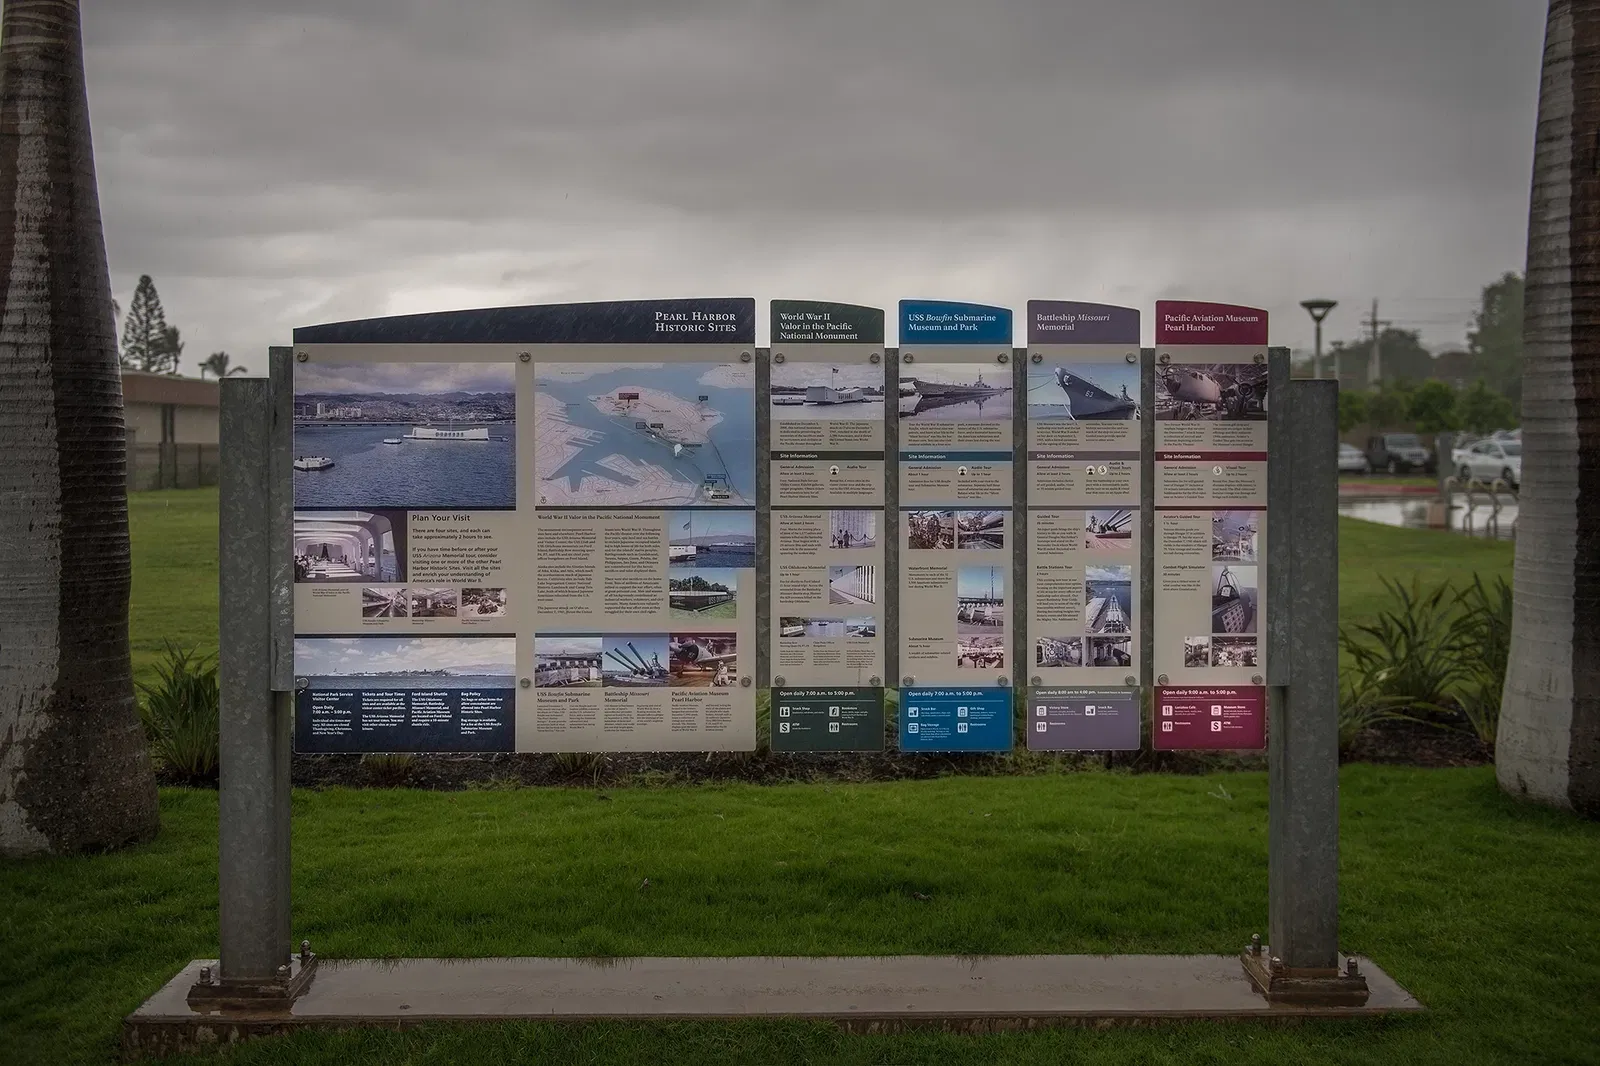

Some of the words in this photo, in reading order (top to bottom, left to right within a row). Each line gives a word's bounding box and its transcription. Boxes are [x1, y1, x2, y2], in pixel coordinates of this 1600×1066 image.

[655, 311, 688, 321] PEARL
[692, 312, 736, 321] HARBOR
[926, 313, 953, 323] Bowfin
[1037, 314, 1076, 323] Battleship
[1165, 314, 1191, 322] Pacific
[1191, 314, 1224, 322] Aviation
[655, 322, 705, 332] HISTORIC
[708, 322, 736, 332] SITES
[780, 322, 801, 330] Valor
[802, 322, 811, 330] in
[812, 322, 825, 330] the
[826, 322, 852, 330] Pacific
[908, 323, 942, 331] Museum
[943, 323, 958, 331] and
[960, 323, 978, 331] Park
[1036, 323, 1074, 331] Memorial
[815, 332, 858, 340] Monument
[1085, 390, 1094, 398] 63
[431, 514, 450, 522] Your
